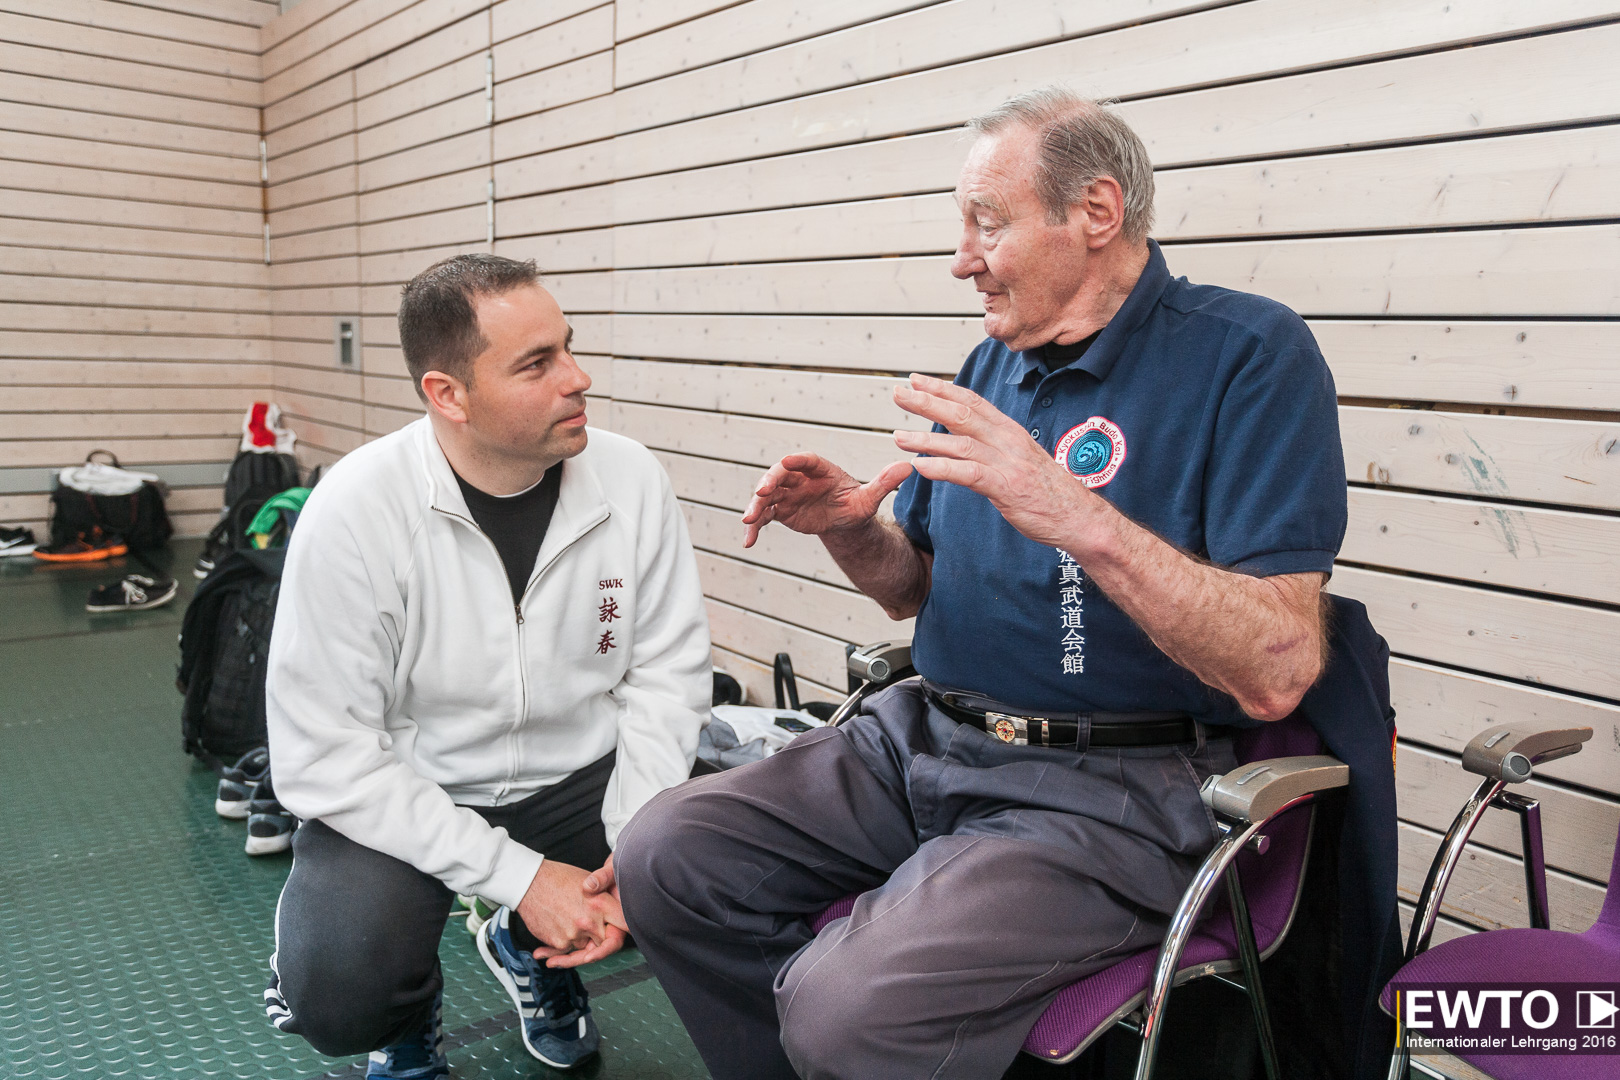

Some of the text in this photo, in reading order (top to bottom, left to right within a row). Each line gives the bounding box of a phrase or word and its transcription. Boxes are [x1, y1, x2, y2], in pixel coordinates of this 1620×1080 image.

[1099, 421, 1118, 440] Budo
[1114, 440, 1123, 456] Kai
[1084, 463, 1117, 485] Fighting
[598, 578, 623, 590] SWK
[594, 596, 621, 655] 詠春
